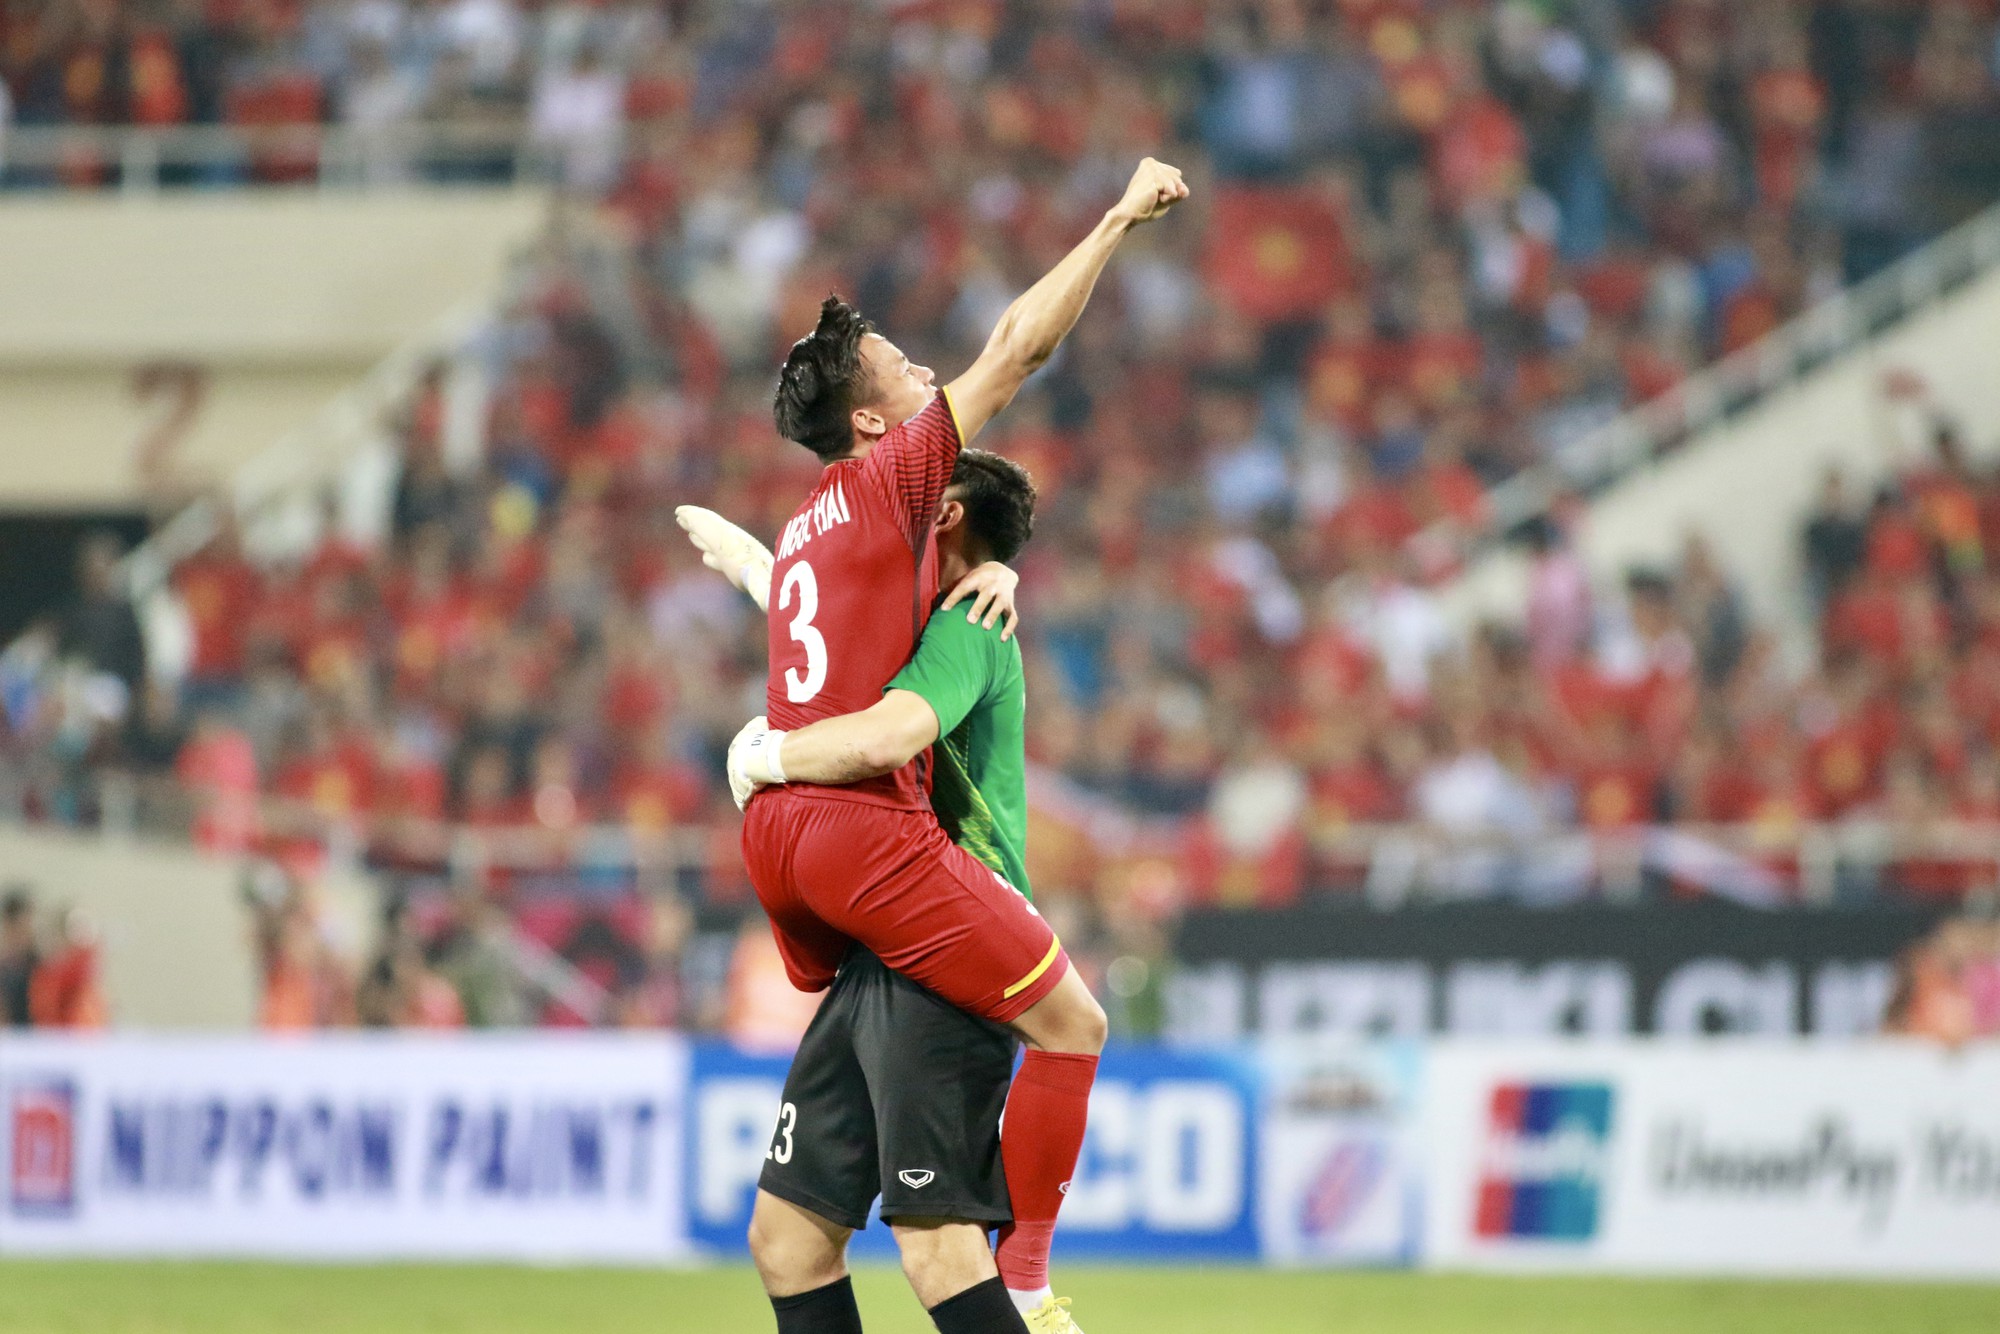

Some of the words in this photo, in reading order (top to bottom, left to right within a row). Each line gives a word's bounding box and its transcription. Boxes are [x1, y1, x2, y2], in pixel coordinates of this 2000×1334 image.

[813, 480, 851, 536] HAI
[779, 560, 828, 704] 3
[102, 1097, 396, 1198] NIPPON
[423, 1097, 659, 1198] PAINT
